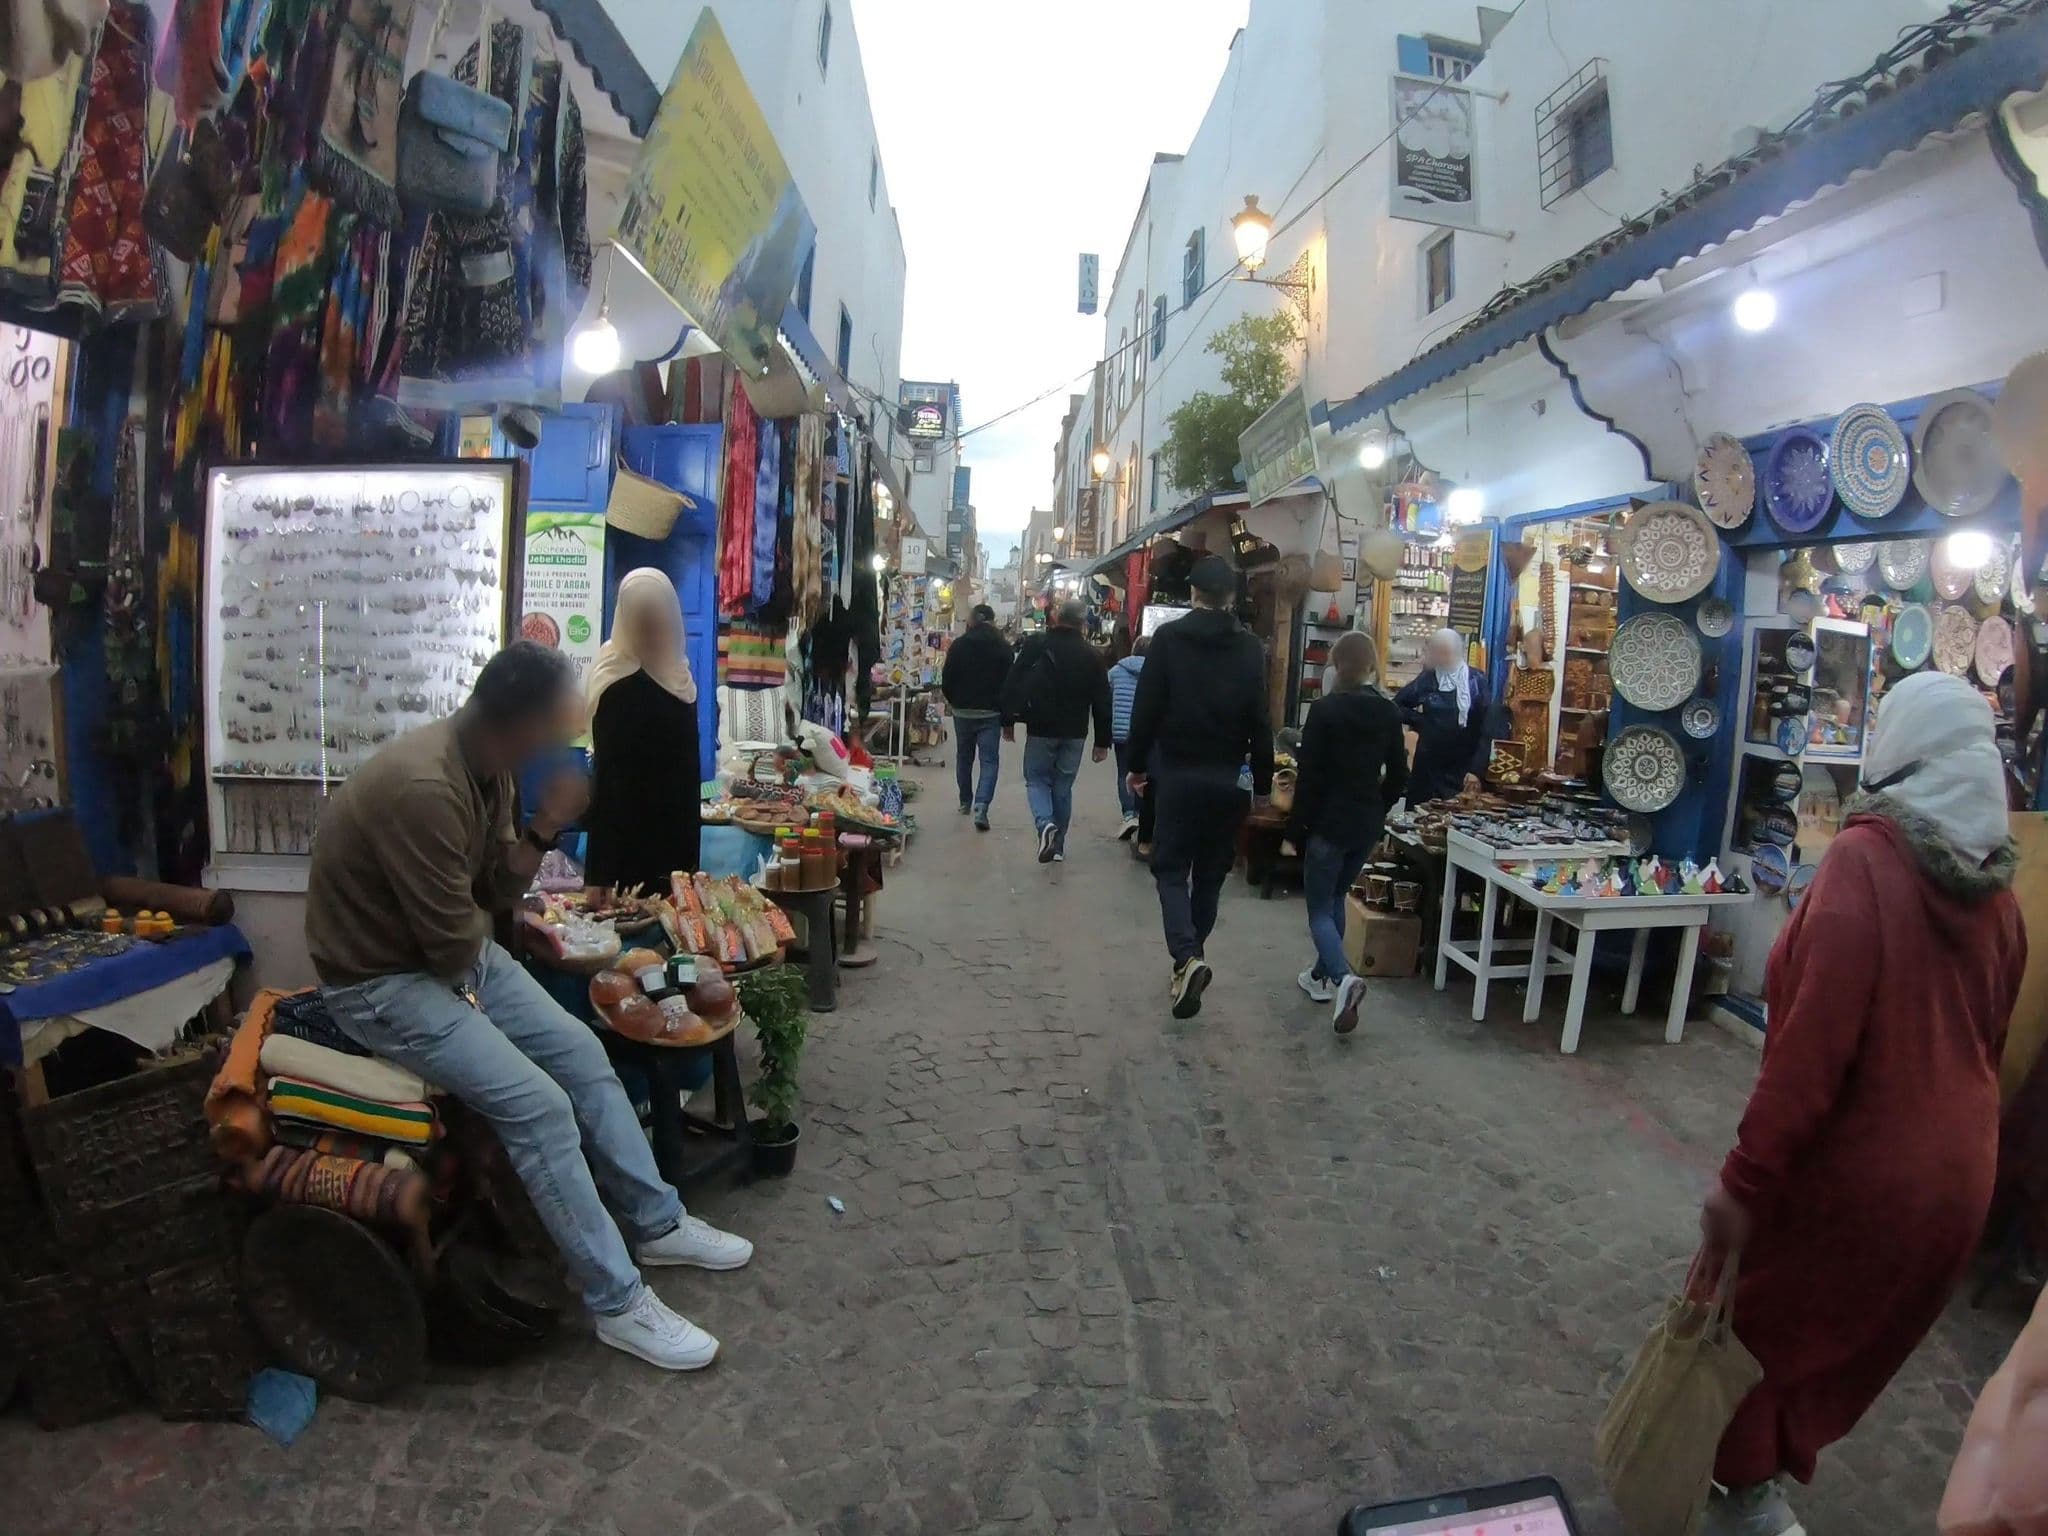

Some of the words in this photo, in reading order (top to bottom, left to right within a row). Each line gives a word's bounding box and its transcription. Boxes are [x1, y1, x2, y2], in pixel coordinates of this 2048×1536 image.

[1405, 153, 1426, 164] SPA
[1083, 255, 1095, 298] RIAD
[907, 545, 920, 555] 10
[530, 555, 554, 564] Jebel
[556, 555, 585, 565] Lhadid
[556, 580, 591, 590] D'ARGAN
